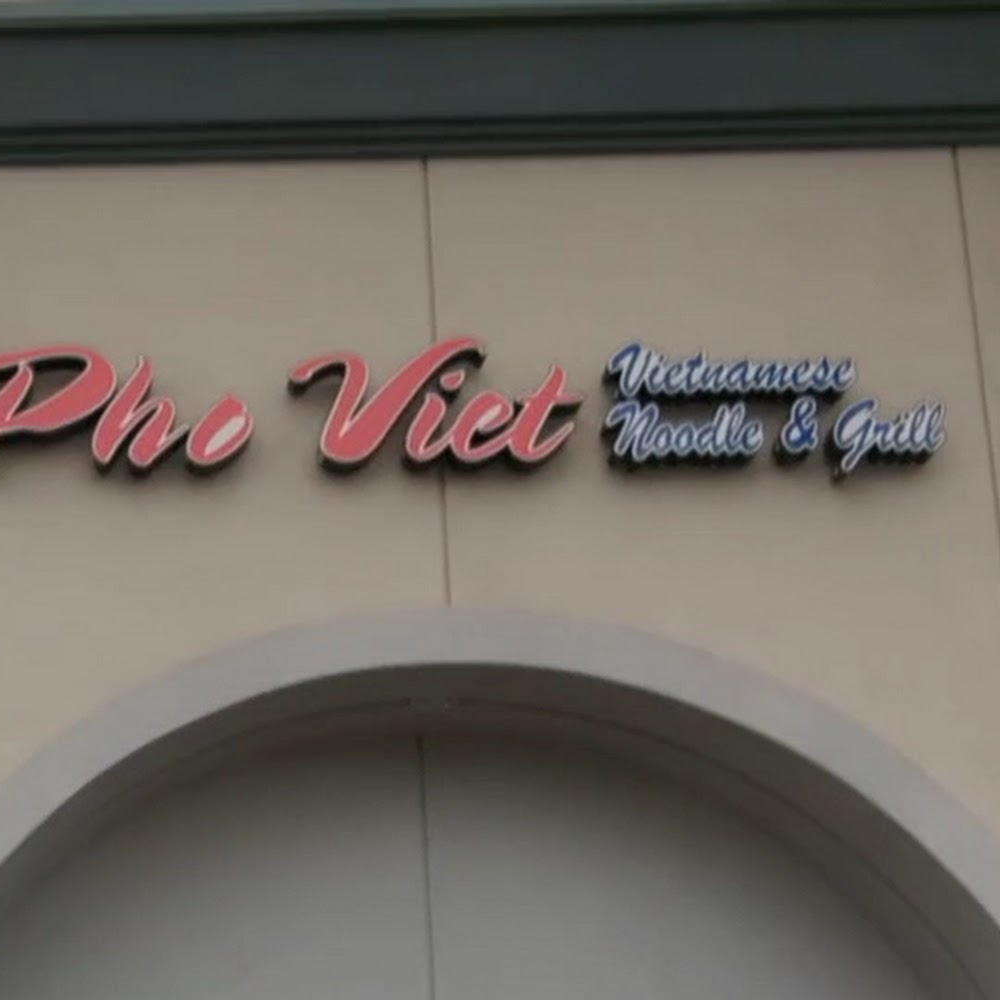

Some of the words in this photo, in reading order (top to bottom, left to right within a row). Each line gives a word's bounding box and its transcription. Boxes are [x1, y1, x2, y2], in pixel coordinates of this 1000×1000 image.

[289, 337, 582, 467] Viet
[607, 343, 855, 397] Vietnamese
[605, 400, 763, 462] Noodle
[780, 396, 819, 453] &
[834, 400, 946, 472] Grill
